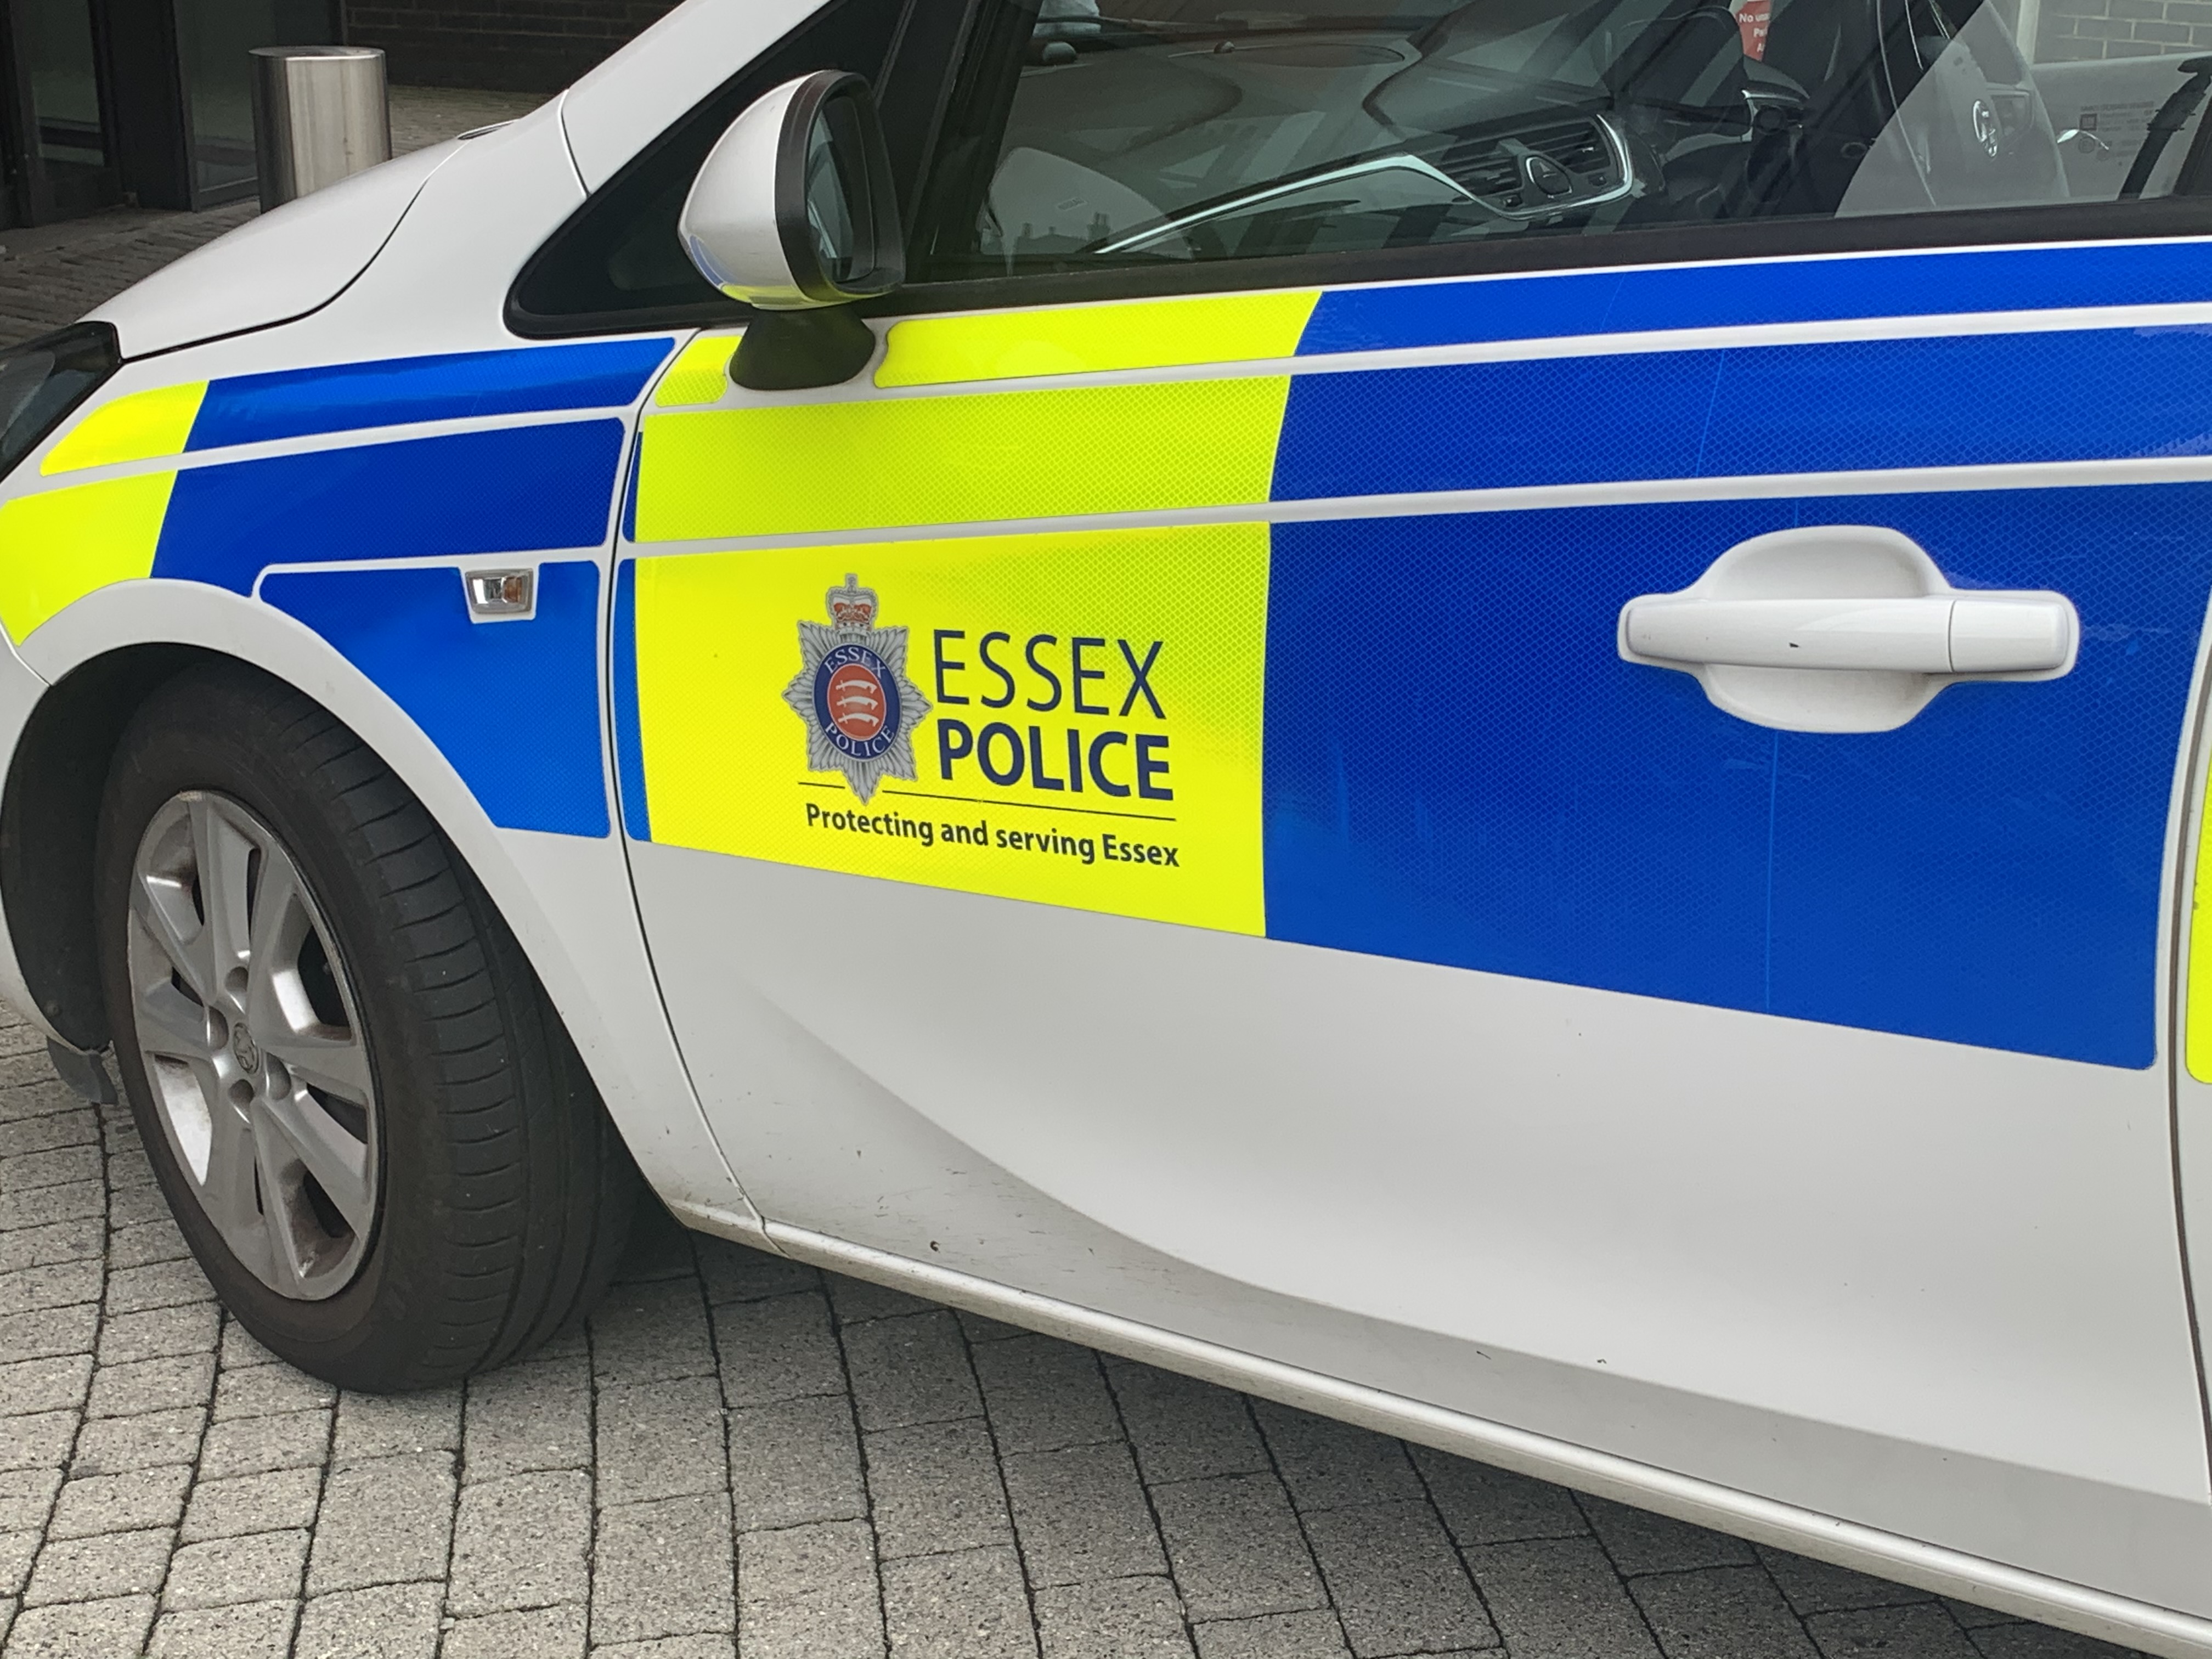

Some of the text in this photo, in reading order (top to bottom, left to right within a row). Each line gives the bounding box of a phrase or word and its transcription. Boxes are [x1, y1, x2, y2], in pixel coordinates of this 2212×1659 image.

[1739, 13, 1754, 23] No
[825, 647, 886, 679] ESSEX
[934, 629, 1166, 720] ESSEX
[825, 722, 894, 757] POLICE
[937, 719, 1173, 801] POLICE
[806, 803, 1180, 867] Protecting and serving Essex
